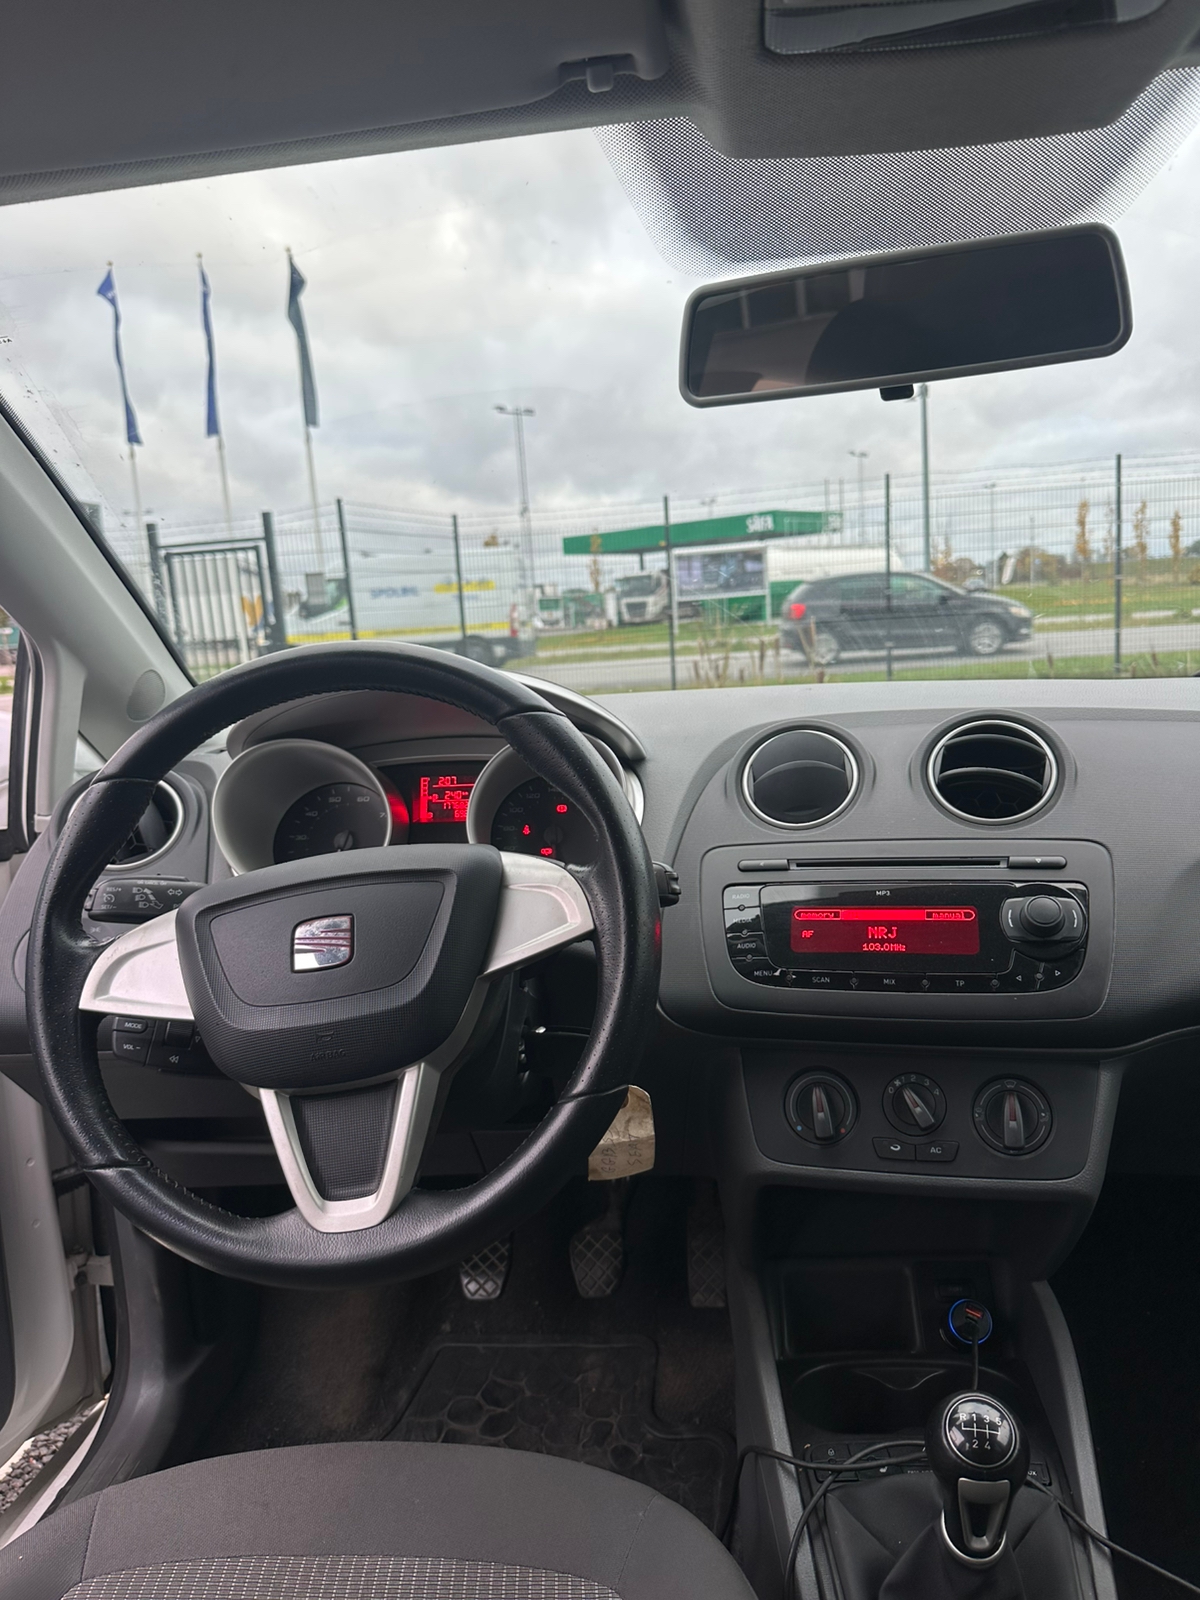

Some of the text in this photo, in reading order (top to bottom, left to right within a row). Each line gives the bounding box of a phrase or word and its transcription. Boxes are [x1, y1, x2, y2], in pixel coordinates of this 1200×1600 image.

[932, 911, 966, 920] manual
[867, 926, 898, 940] NRJ
[736, 942, 757, 950] AUDIO
[811, 976, 830, 984] SCAN
[883, 978, 896, 986] MIX
[124, 1021, 143, 1030] MODE
[910, 1074, 916, 1082] 2
[923, 1078, 930, 1086] 3
[933, 1088, 940, 1096] 4
[930, 1146, 942, 1154] AC
[959, 1412, 1002, 1426] R 1 3 5
[972, 1439, 991, 1450] 2 4
